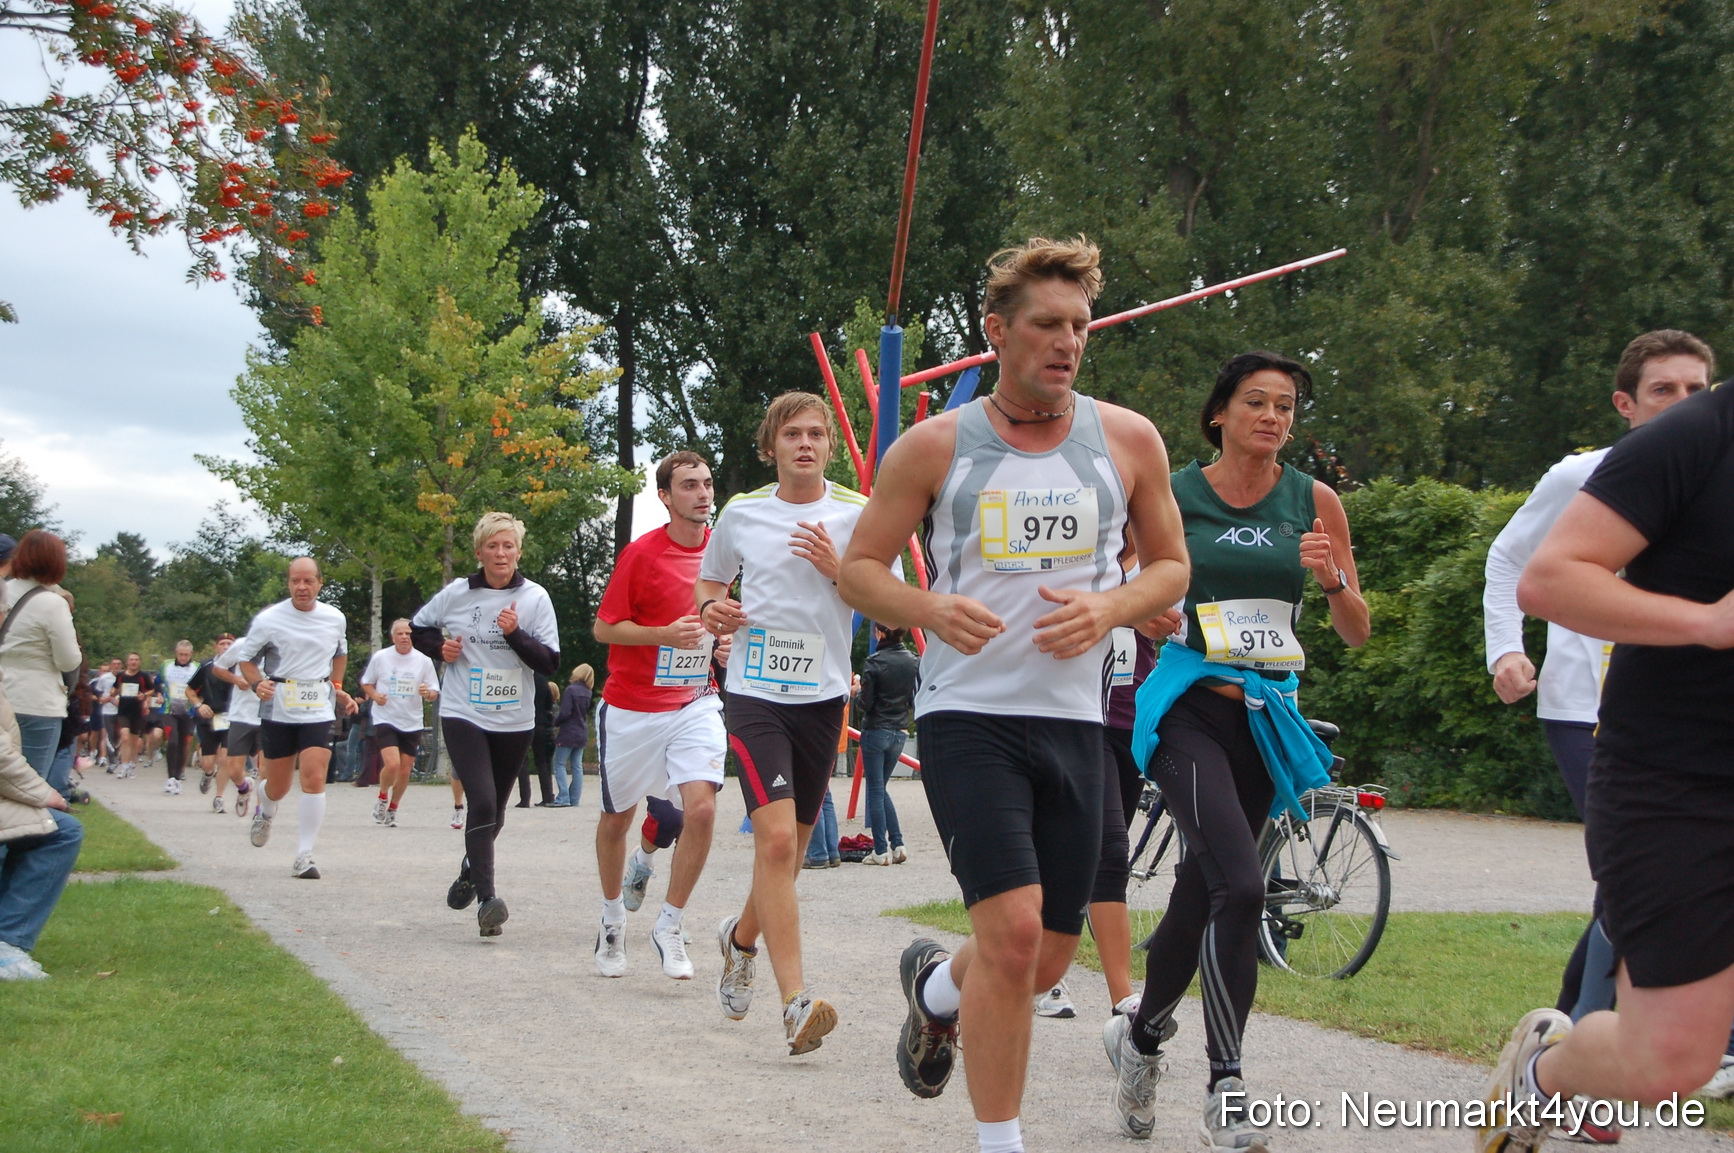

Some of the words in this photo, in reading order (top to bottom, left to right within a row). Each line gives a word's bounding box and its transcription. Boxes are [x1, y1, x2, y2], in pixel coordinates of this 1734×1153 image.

[1014, 488, 1081, 507] André
[1023, 515, 1078, 542] 979
[1215, 526, 1274, 547] AOK
[1008, 539, 1033, 554] SW
[1223, 608, 1270, 626] Renate
[480, 638, 507, 646] Neumar
[769, 635, 805, 651] Dominik
[1240, 629, 1284, 651] 978
[675, 655, 706, 669] 2277
[768, 654, 814, 673] 3077
[301, 691, 319, 701] 269
[486, 684, 517, 697] 2666
